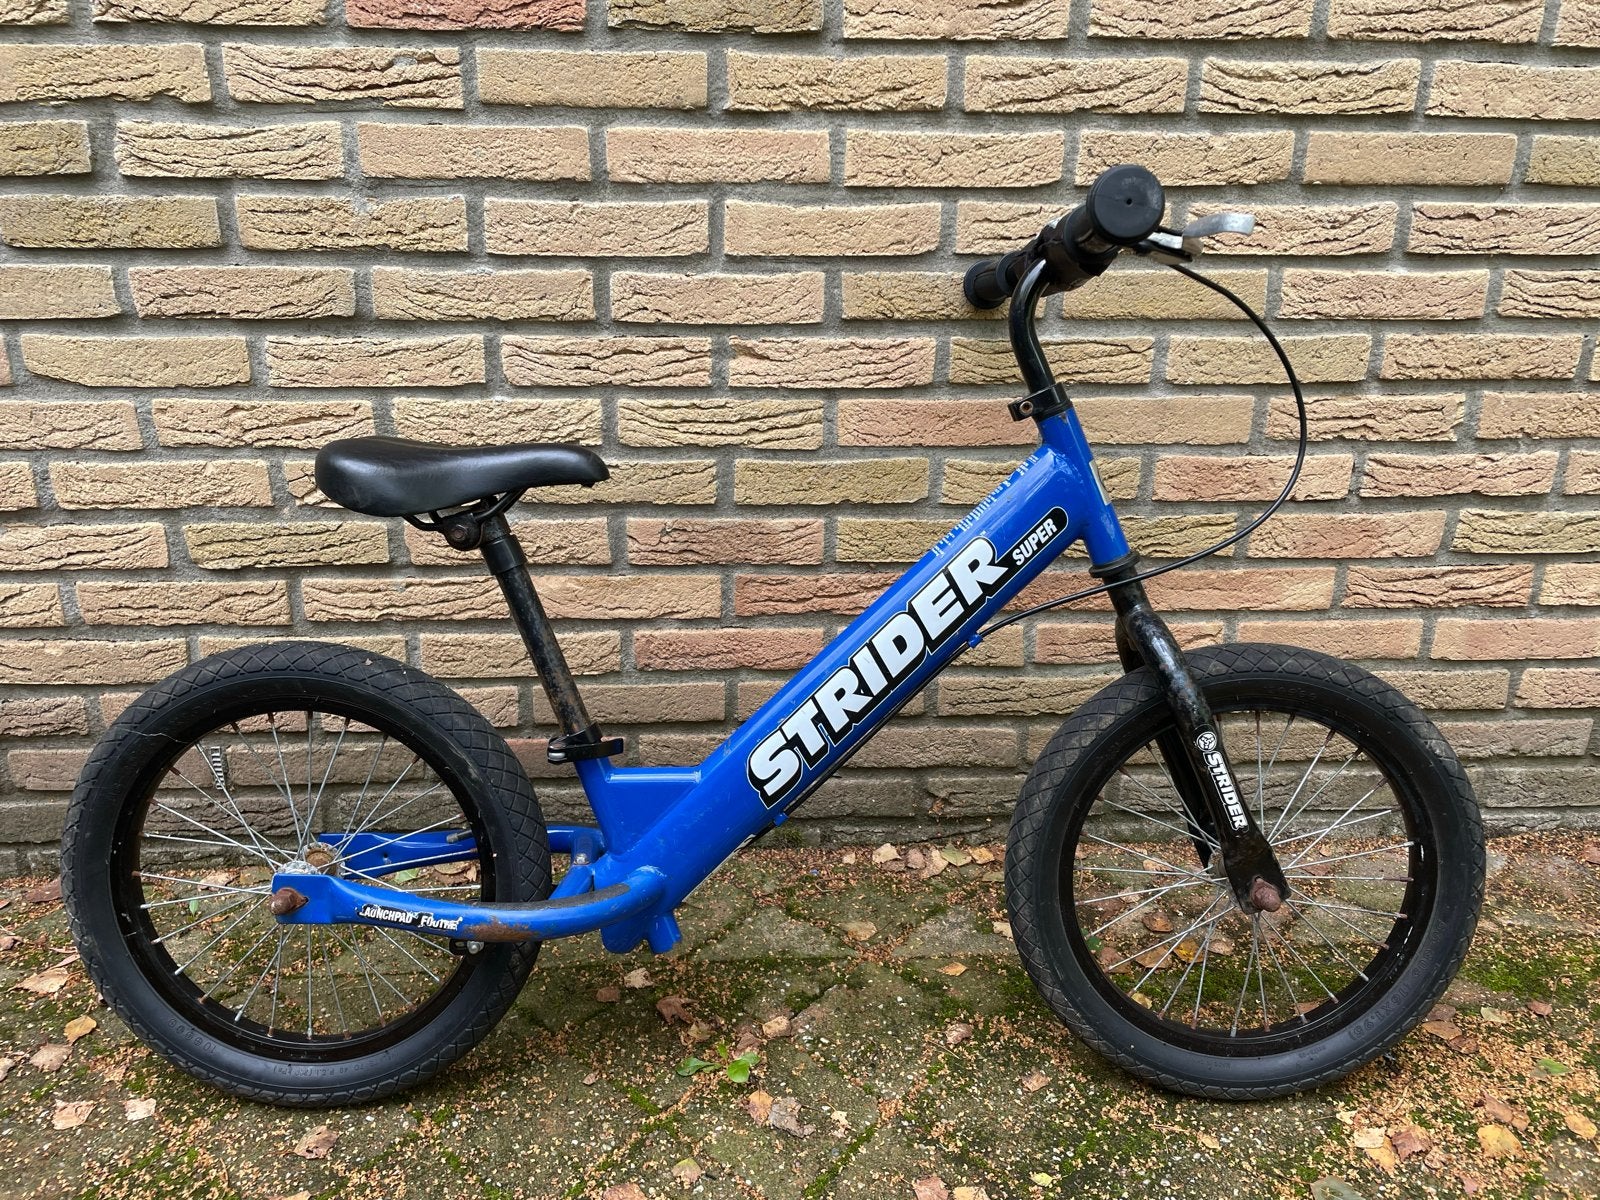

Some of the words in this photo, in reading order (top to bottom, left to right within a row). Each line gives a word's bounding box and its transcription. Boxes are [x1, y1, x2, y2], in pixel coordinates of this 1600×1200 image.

[1012, 518, 1058, 566] SUPER
[750, 539, 1011, 796] STRIDER
[1207, 752, 1248, 829] STRIDER
